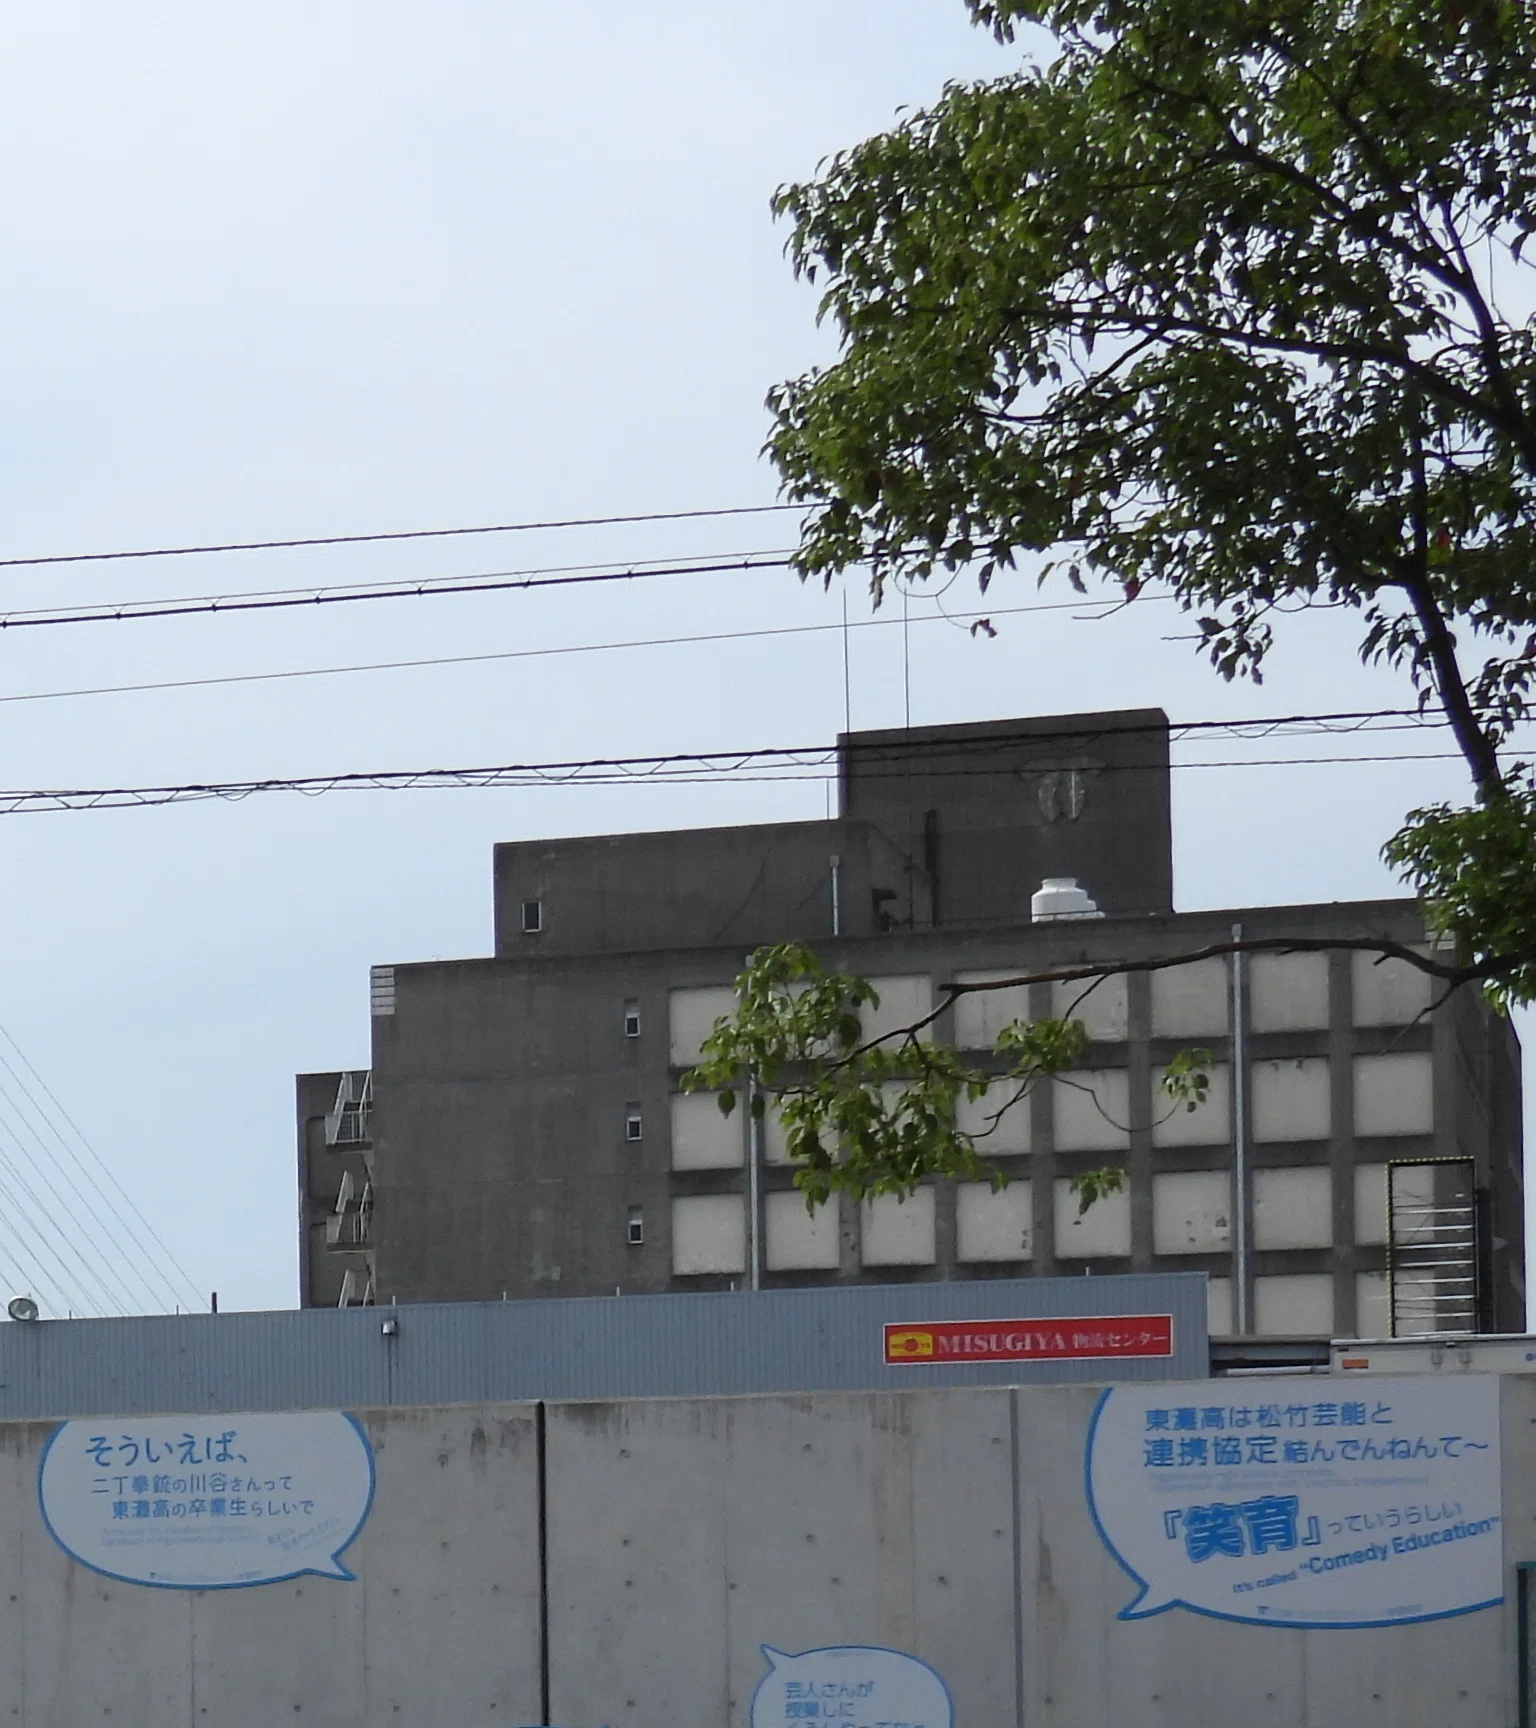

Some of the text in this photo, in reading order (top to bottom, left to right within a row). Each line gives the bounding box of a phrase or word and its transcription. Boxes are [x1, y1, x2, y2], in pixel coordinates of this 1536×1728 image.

[938, 1332, 1066, 1353] MISUGIYA
[1072, 1332, 1168, 1349] 物流センター
[1144, 1401, 1393, 1432] 東灘高は松竹芸能と
[86, 1430, 249, 1466] そういえば、
[91, 1472, 293, 1496] 二丁拳銃の川谷さんって
[112, 1498, 316, 1520] 東灘高の卒業生らしいで
[1255, 1569, 1298, 1588] called
[785, 1680, 875, 1699] 芸人さんが
[785, 1702, 856, 1718] 授業しに
